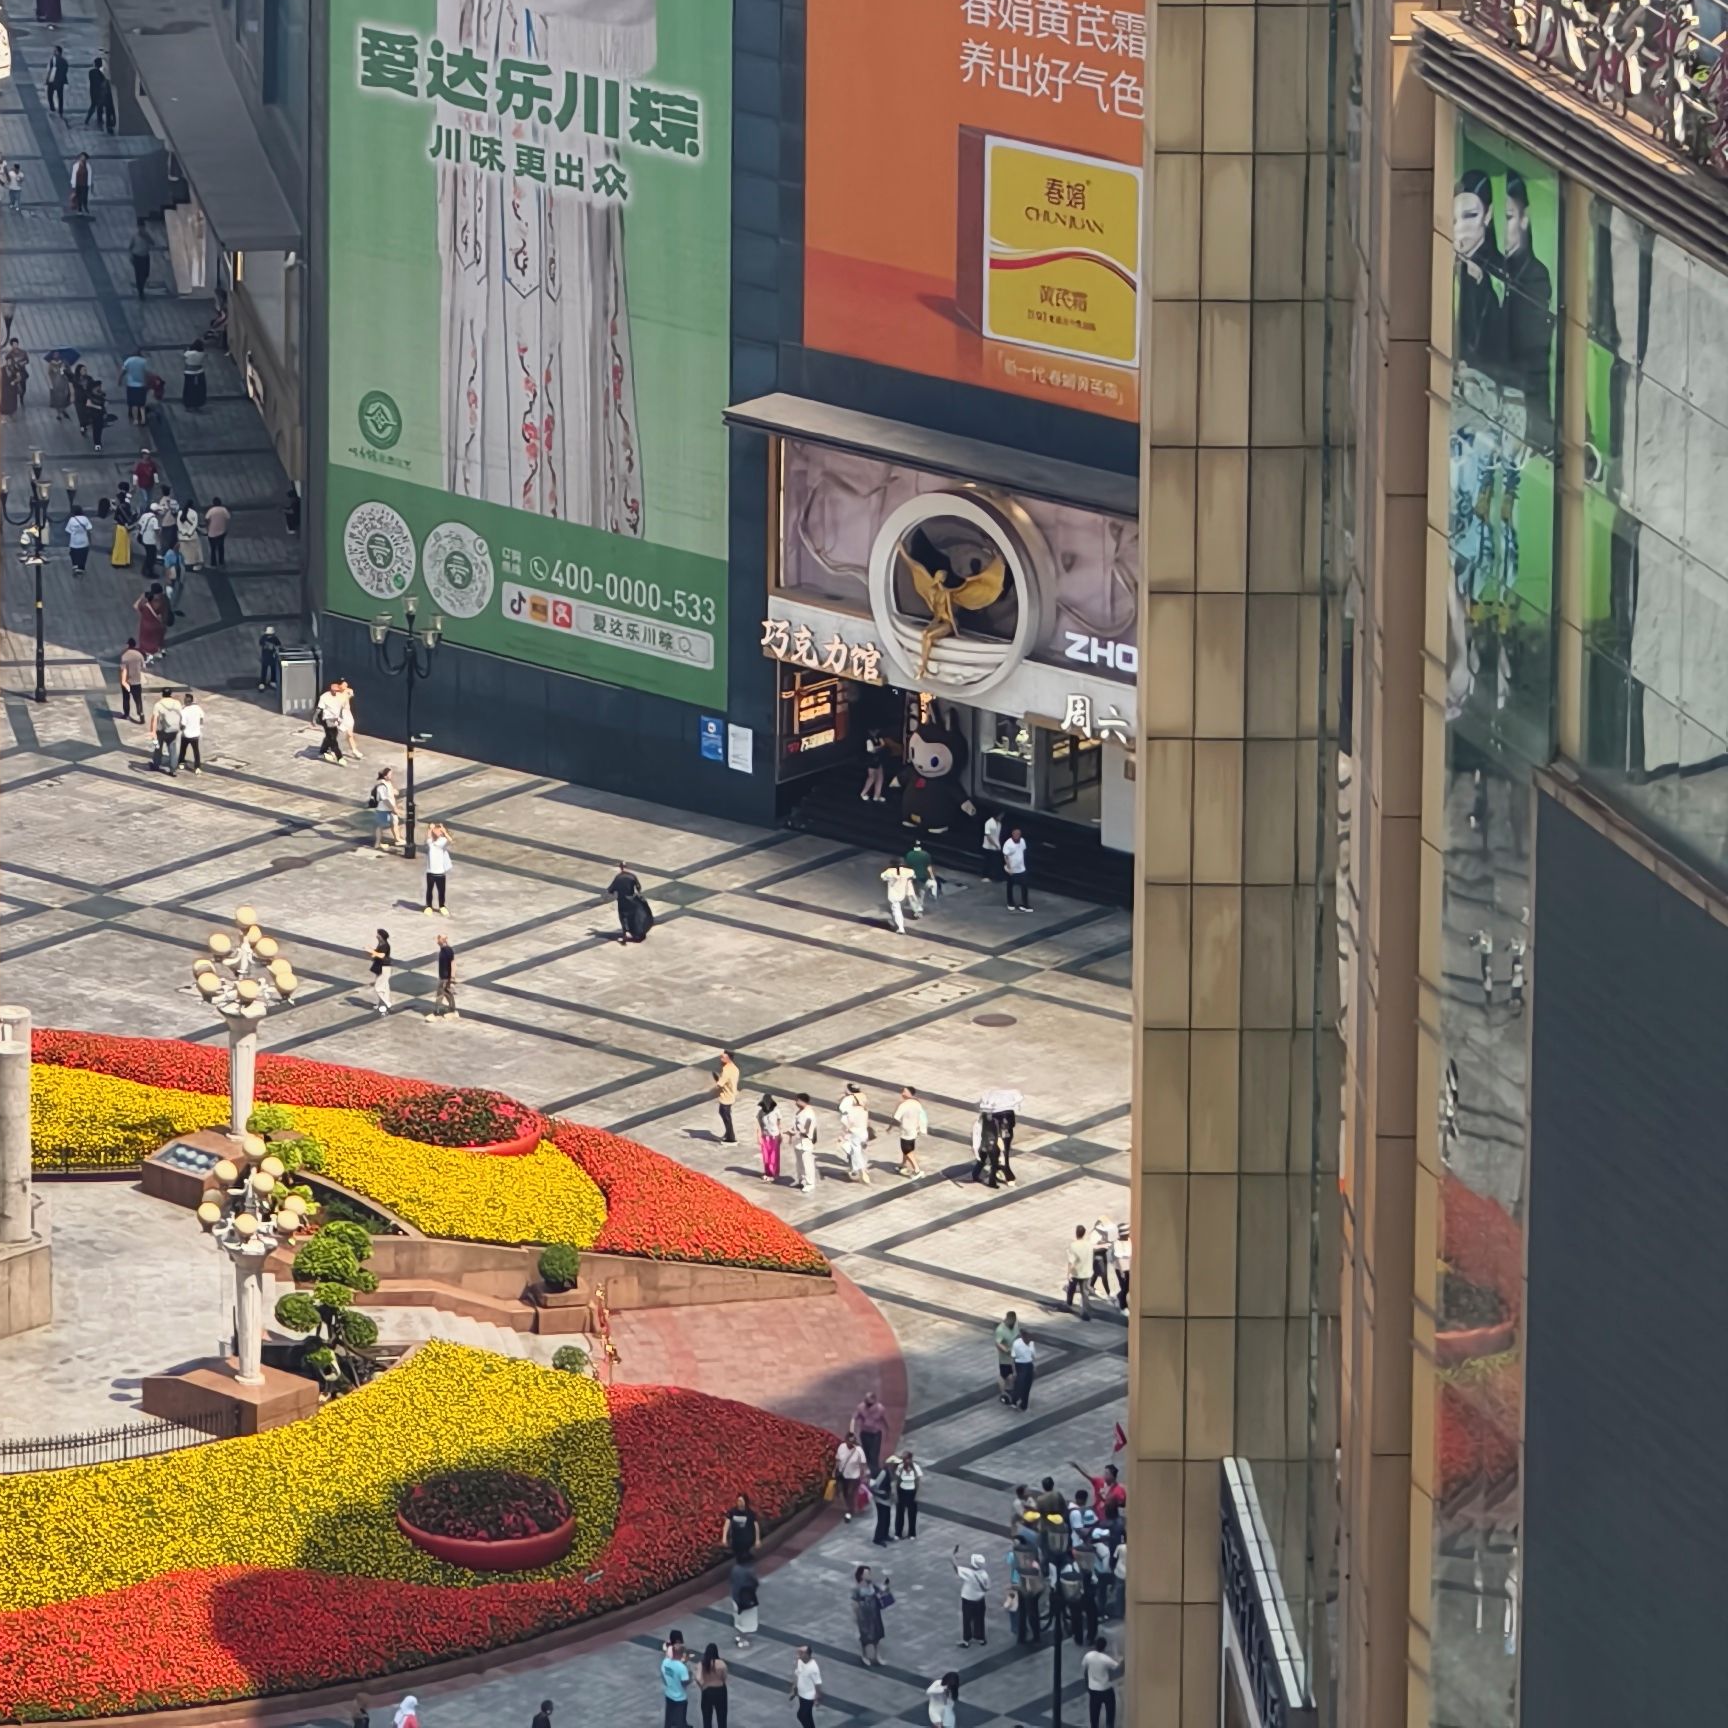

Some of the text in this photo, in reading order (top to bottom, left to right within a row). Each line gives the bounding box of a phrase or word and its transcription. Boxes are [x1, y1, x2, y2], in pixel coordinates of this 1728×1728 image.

[361, 27, 700, 158] 爱达乐川粽
[960, 38, 1145, 120] 养出好气色
[429, 125, 628, 201] 川味更出众
[551, 559, 716, 626] 400-0000-533
[761, 620, 881, 681] 巧克力馆
[1064, 631, 1139, 673] ZHO
[1061, 694, 1129, 745] 周六
